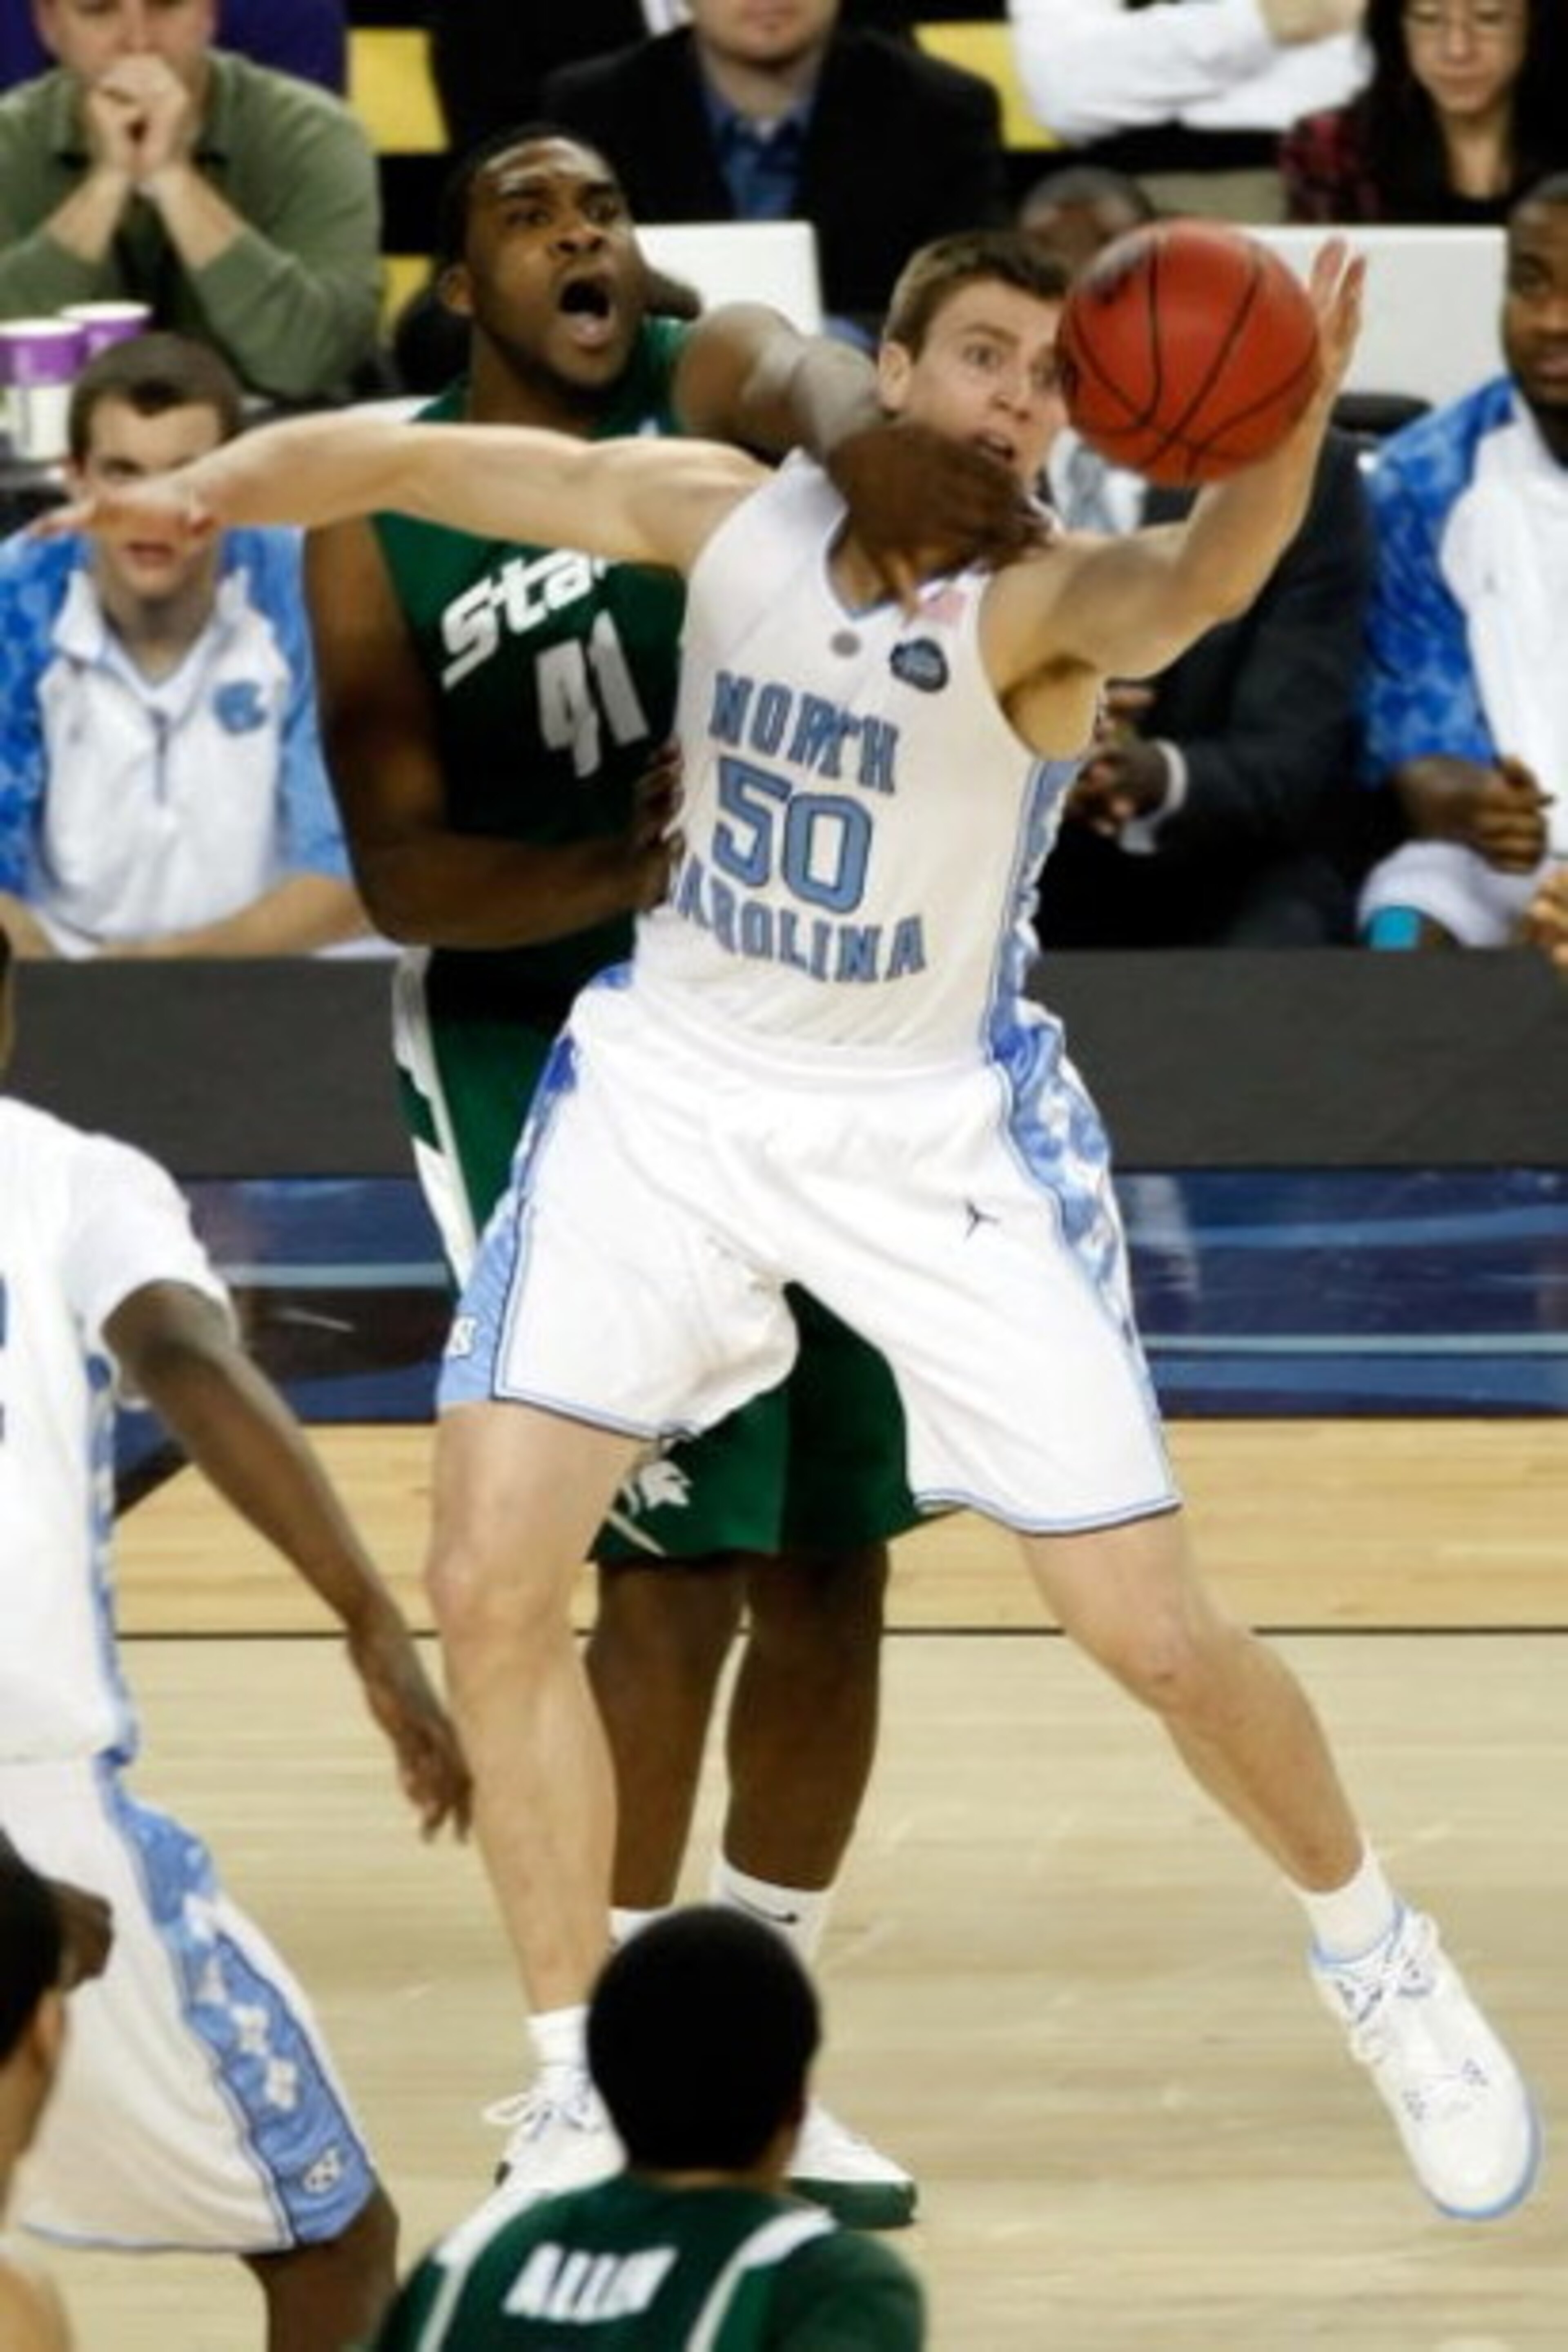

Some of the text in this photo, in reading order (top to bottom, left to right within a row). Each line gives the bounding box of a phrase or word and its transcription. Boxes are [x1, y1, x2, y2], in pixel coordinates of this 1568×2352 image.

[441, 548, 609, 692] Sta
[536, 609, 649, 778] 41
[708, 670, 900, 796] NORTH
[711, 755, 872, 915] 50
[670, 853, 925, 982] AROLINA
